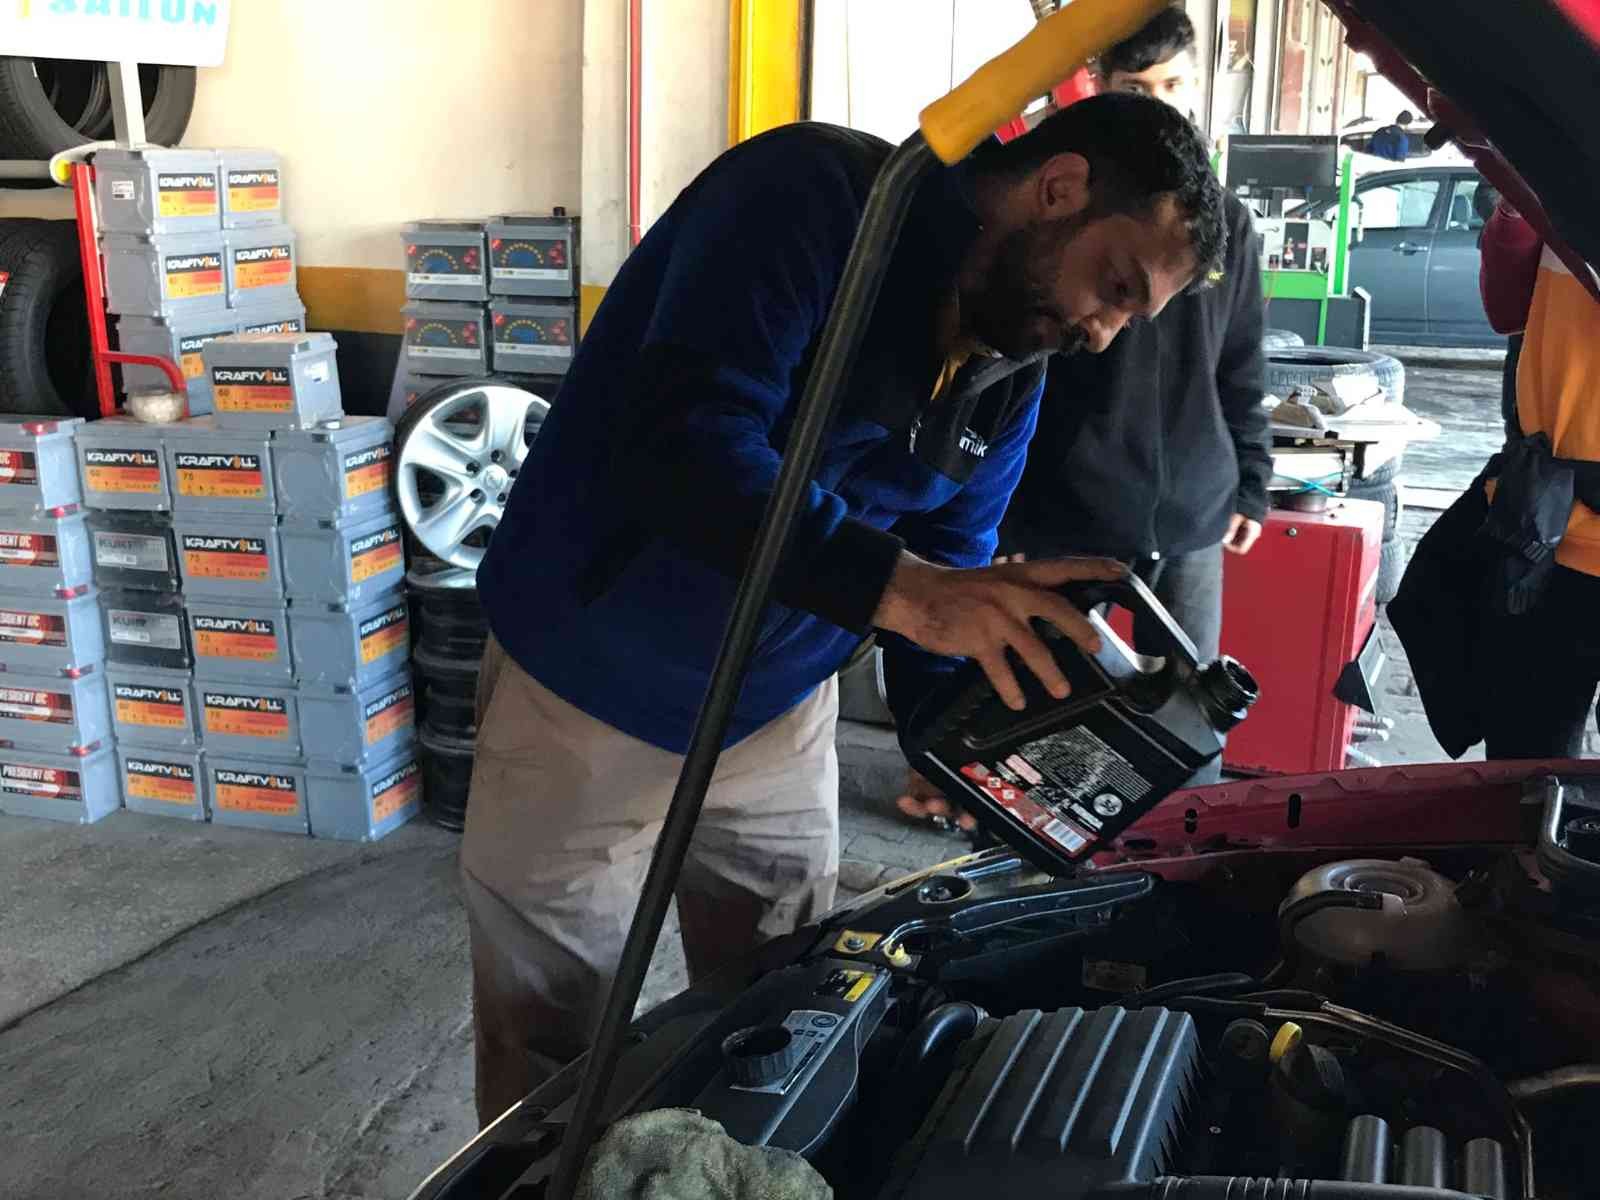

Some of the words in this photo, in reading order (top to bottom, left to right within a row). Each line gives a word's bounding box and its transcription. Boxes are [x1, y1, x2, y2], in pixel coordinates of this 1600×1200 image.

[215, 369, 287, 383] KRAFTVOLL
[179, 455, 256, 469] KRAFTVOLL
[186, 537, 262, 552] KRAFTVOLL
[196, 617, 270, 633] KRAFTVOLL
[207, 695, 282, 711] KRAFTVOLL
[217, 771, 292, 788] KRAFTVOLL
